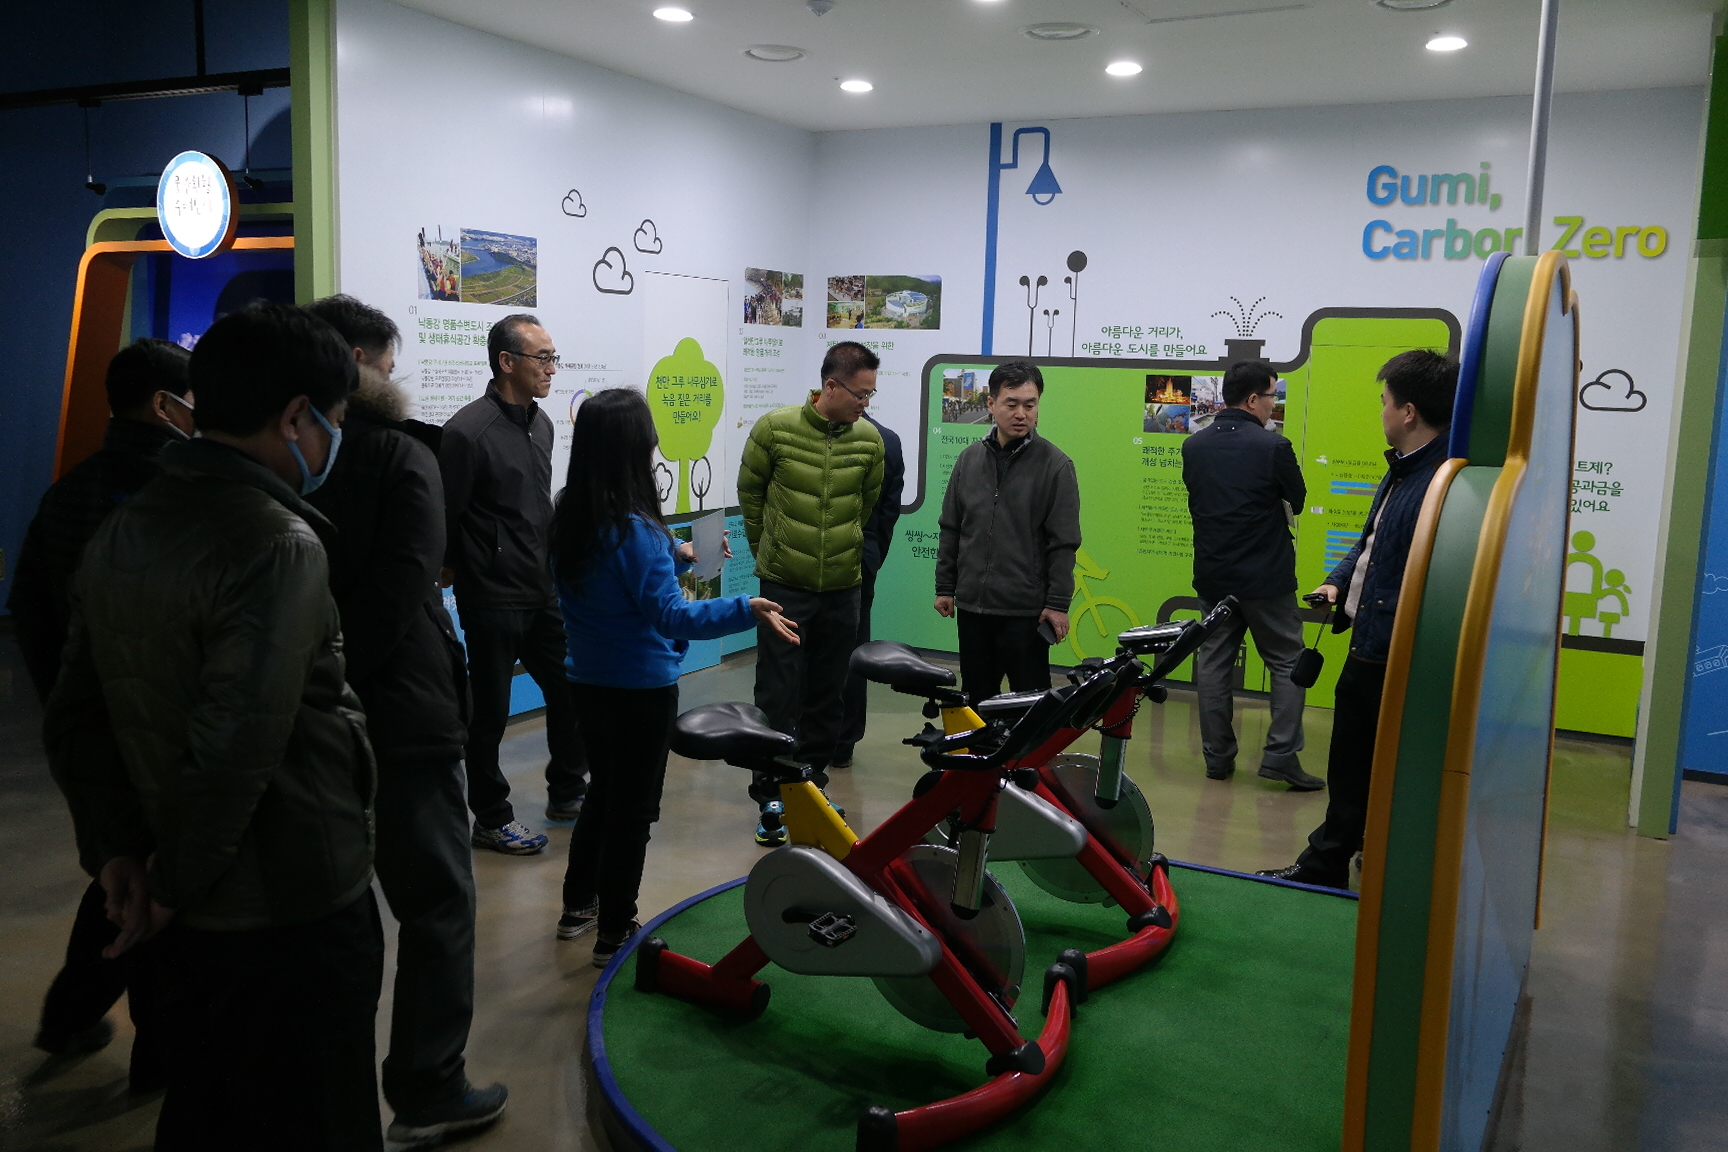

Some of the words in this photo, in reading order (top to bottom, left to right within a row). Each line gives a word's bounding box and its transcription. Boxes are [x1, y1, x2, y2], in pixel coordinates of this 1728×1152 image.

[1366, 161, 1502, 211] Gumi,
[1549, 215, 1668, 259] Zero
[418, 317, 440, 330] 낙동강
[418, 332, 427, 344] 및
[1101, 325, 1144, 340] 아름다운
[1147, 326, 1184, 340] 거리가,
[1081, 342, 1123, 356] 아름다운
[1126, 343, 1160, 357] 도시를
[1163, 343, 1208, 358] 만들어요
[655, 375, 670, 390] 천만
[671, 376, 685, 388] 그루
[687, 376, 718, 390] 나무심기로
[662, 393, 676, 407] 녹음
[692, 393, 712, 407] 거리를
[1141, 457, 1157, 467] 개성
[1574, 460, 1613, 475] 트제?
